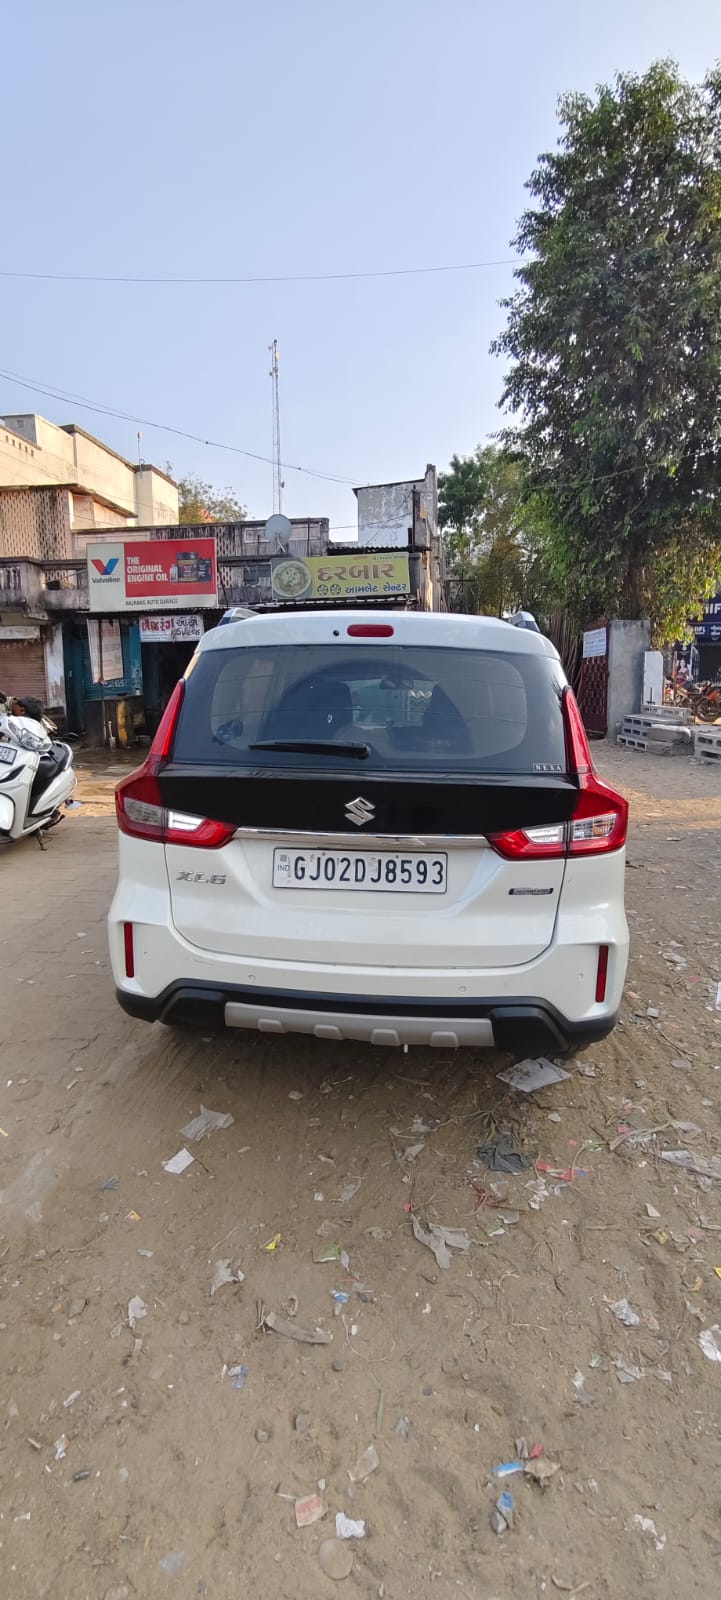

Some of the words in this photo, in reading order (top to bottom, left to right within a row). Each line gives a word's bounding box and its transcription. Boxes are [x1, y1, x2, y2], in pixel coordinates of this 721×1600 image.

[126, 556, 140, 565] THE
[126, 564, 163, 574] ORIGINAL
[317, 563, 395, 582] દરબાર
[127, 574, 155, 583] ENGINE
[155, 573, 169, 582] OIL
[277, 863, 290, 872] IND
[293, 856, 444, 885] GJ02DJ8593
[175, 871, 227, 885] XL6
